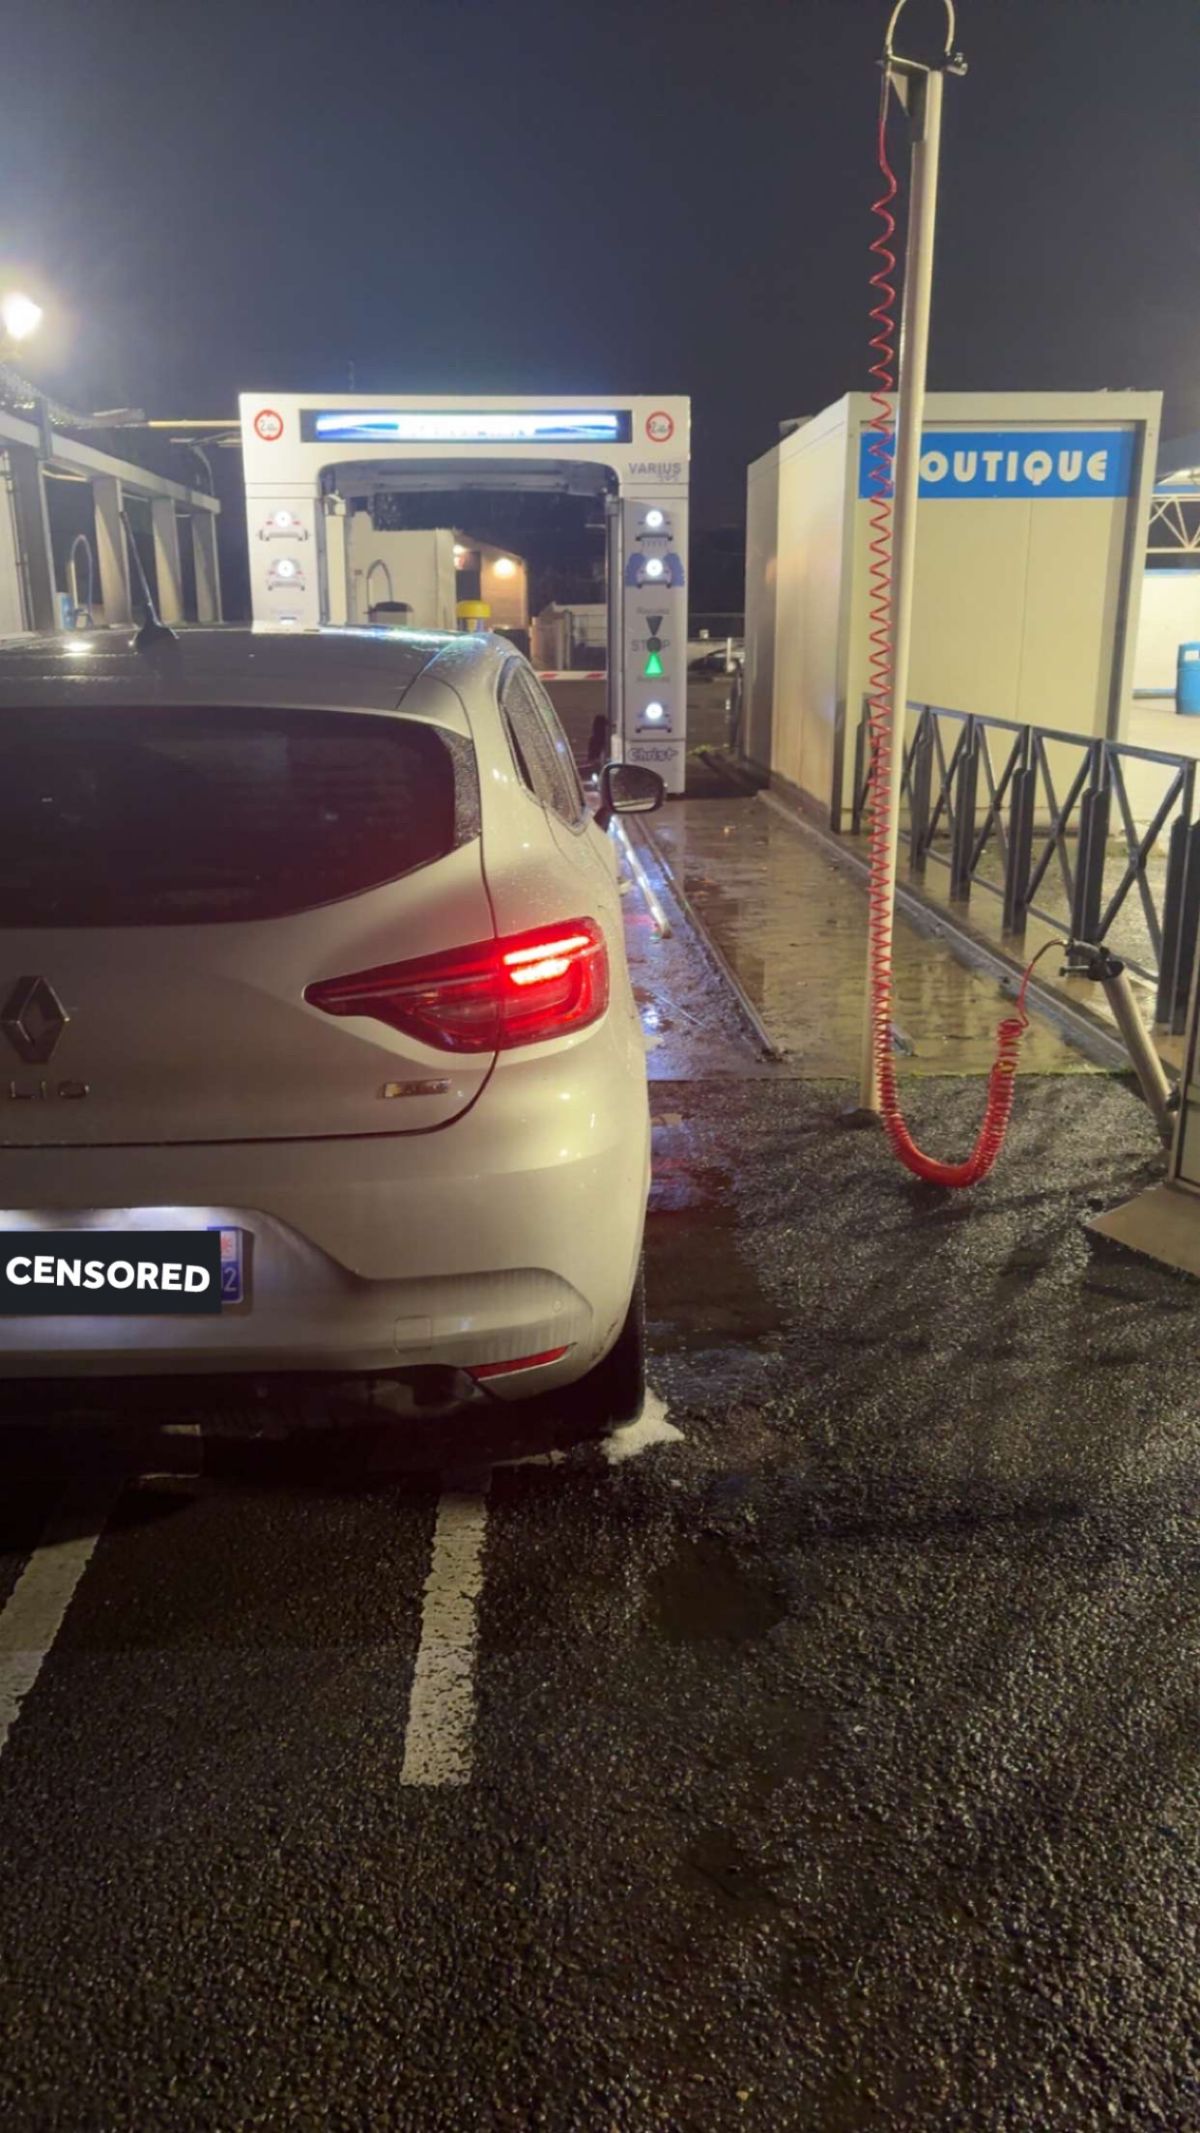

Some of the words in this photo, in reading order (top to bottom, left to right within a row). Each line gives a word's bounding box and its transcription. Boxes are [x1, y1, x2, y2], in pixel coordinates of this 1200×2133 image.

[628, 462, 681, 474] VARIUS
[918, 450, 1107, 486] OUTIQUE
[9, 1081, 91, 1100] LIO
